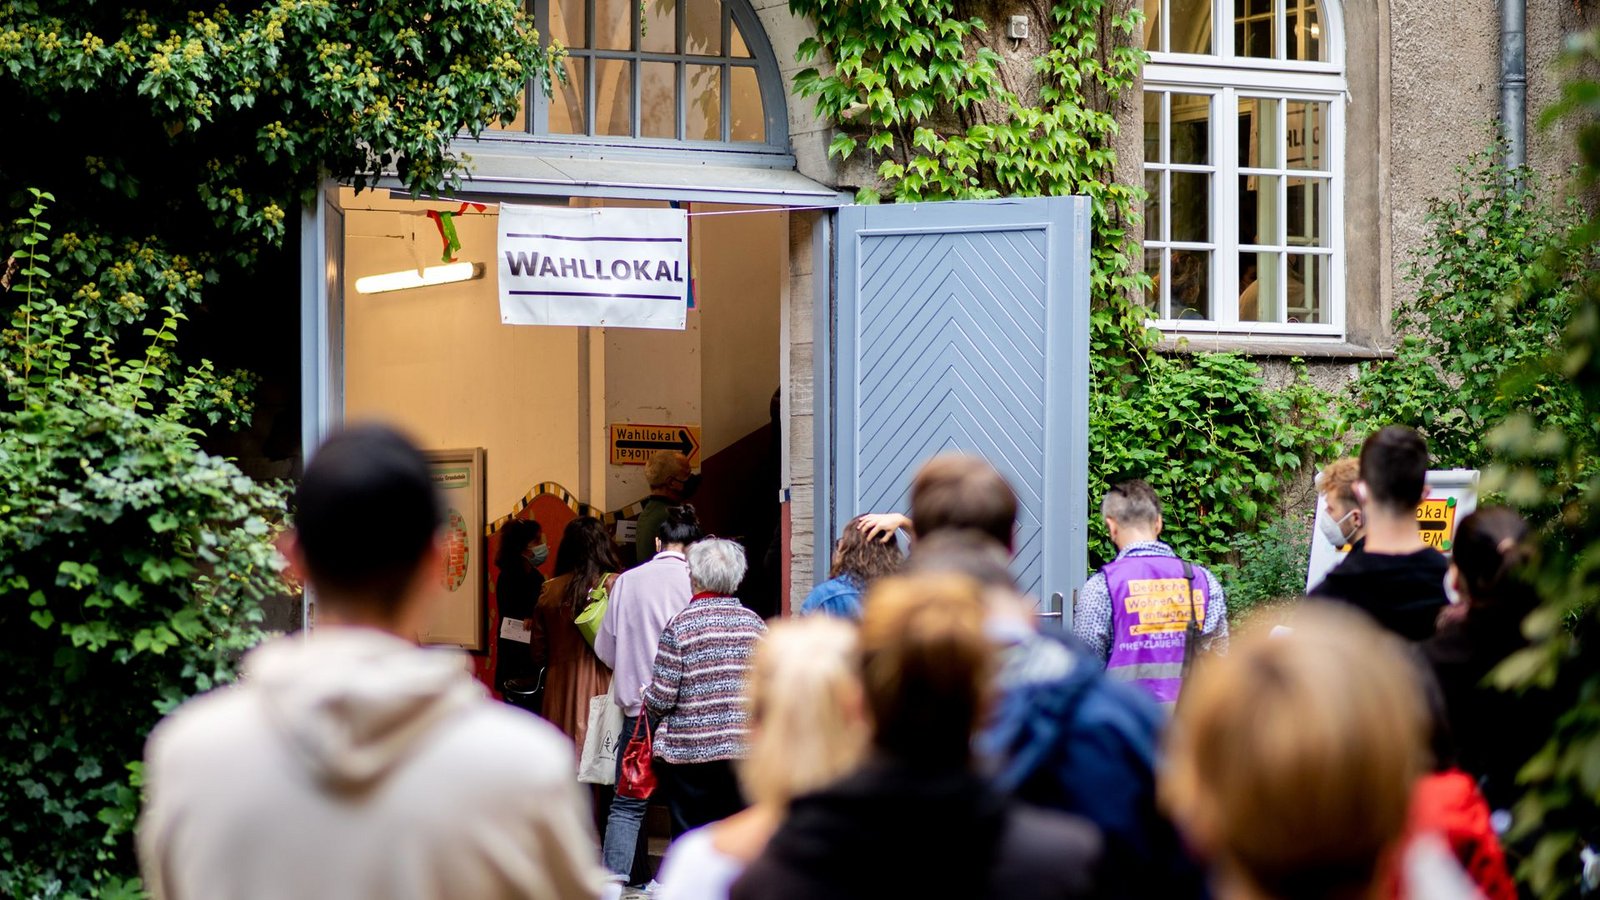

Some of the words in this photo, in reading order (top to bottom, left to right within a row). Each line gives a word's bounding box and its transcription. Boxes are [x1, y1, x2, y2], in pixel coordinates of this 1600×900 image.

[505, 250, 683, 282] WAHLLOKAL
[616, 428, 675, 441] Wahllokal
[616, 449, 657, 460] llokal
[1415, 505, 1448, 519] okal
[1133, 582, 1186, 593] Deutsche
[1128, 597, 1174, 609] Wohnen
